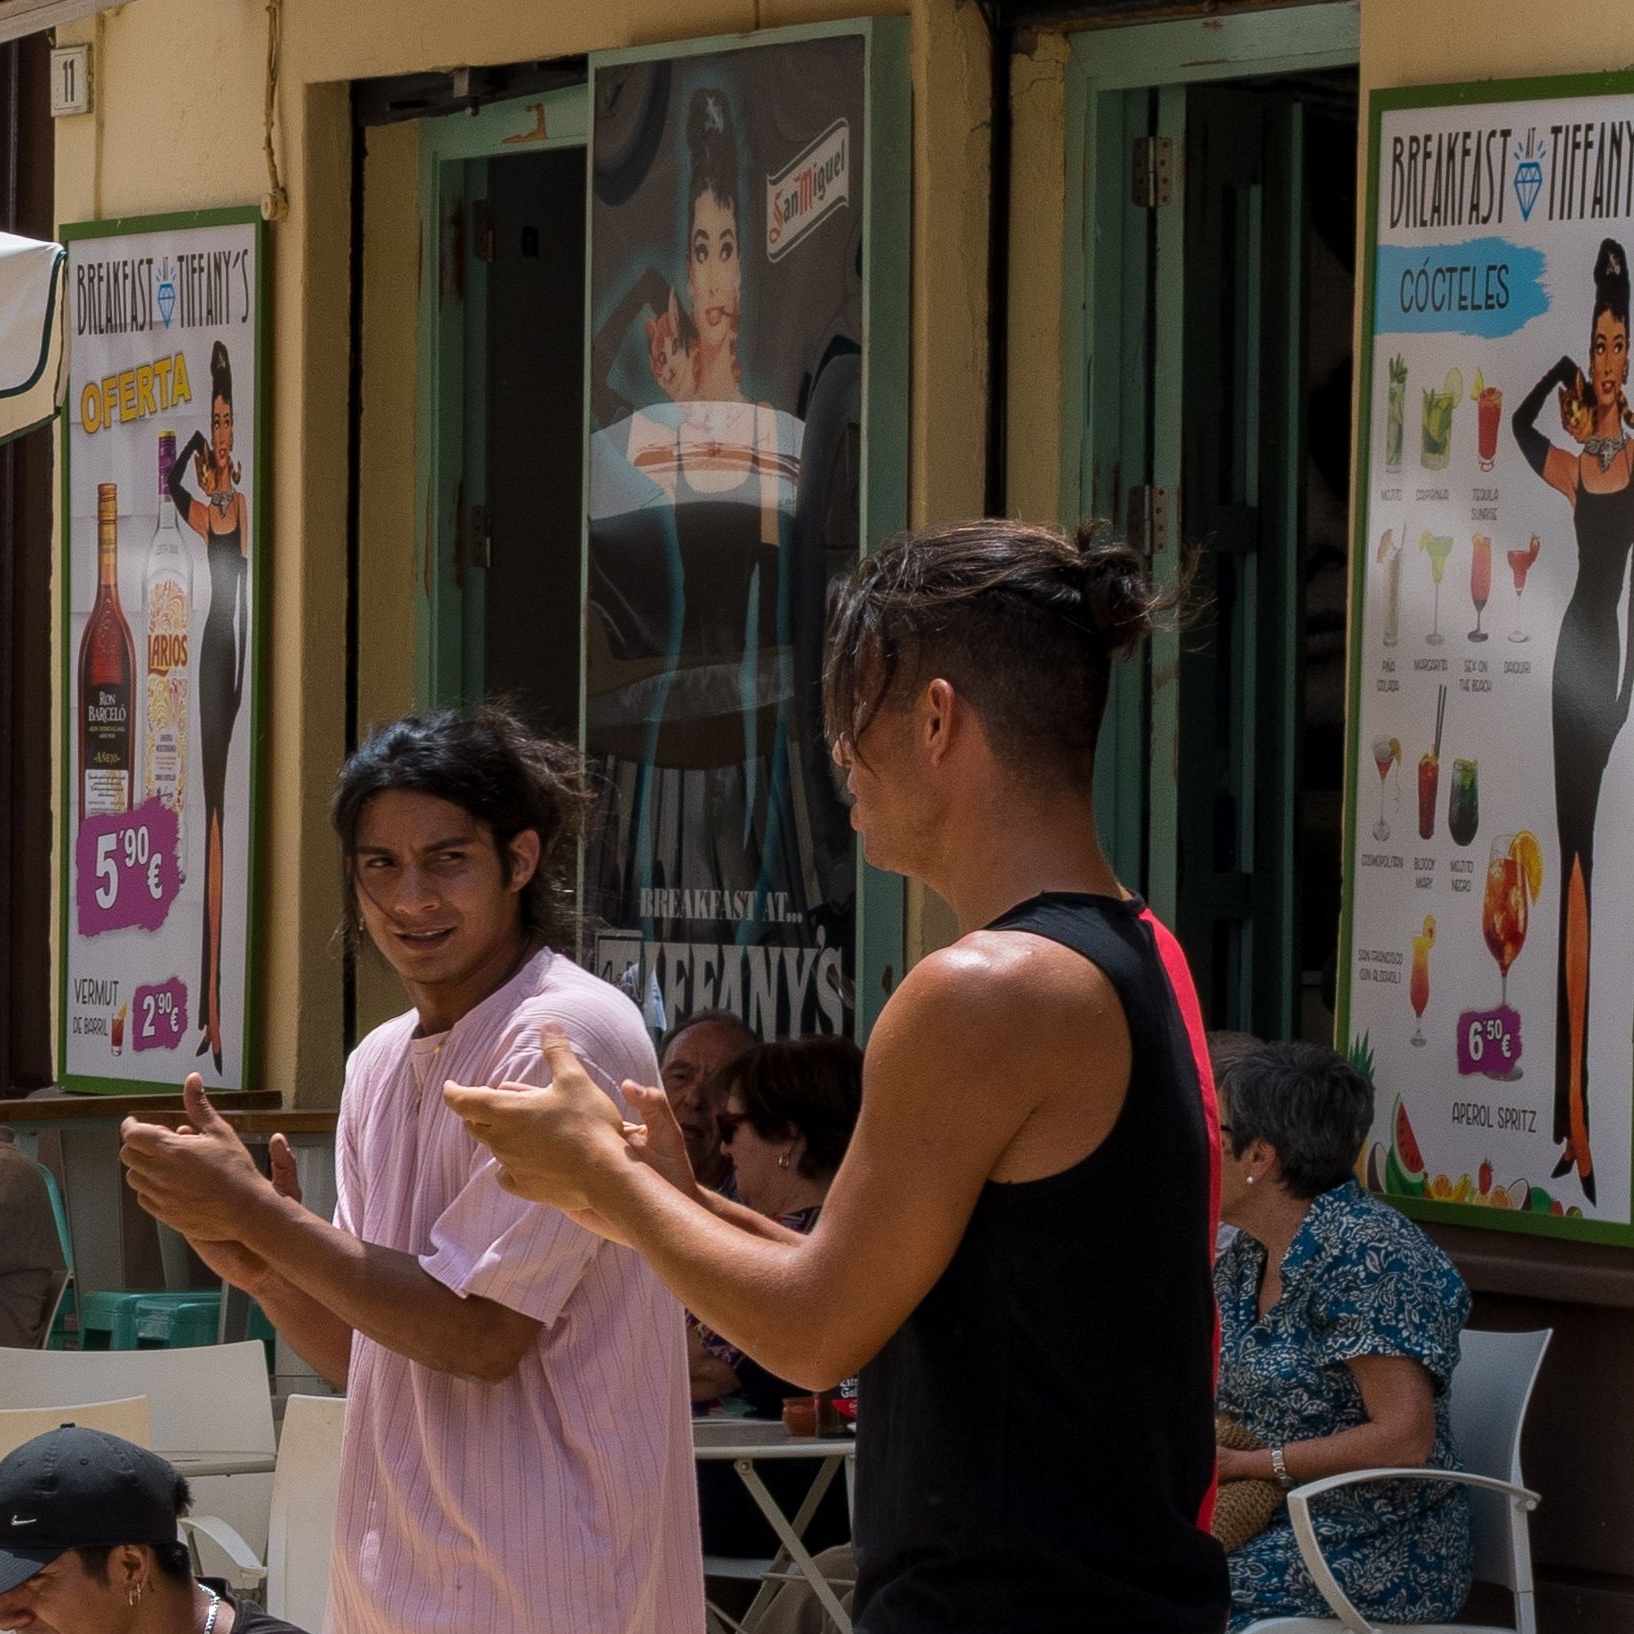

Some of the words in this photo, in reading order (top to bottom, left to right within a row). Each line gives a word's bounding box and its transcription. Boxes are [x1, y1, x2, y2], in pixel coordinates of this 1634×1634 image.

[63, 58, 76, 102] 11
[1390, 129, 1512, 230] BREAKFAST
[77, 256, 154, 335] BREAKFAST
[1400, 256, 1510, 313] CÓCTELES
[80, 351, 192, 434] OFERTA
[148, 634, 189, 677] LARIOS
[88, 704, 126, 723] BARCELÓ
[639, 887, 759, 921] BREAKFAST
[74, 978, 119, 1007] VERMUT
[73, 1017, 83, 1035] DE
[84, 1017, 108, 1036] BARRIL
[1452, 1102, 1494, 1128] APEROL
